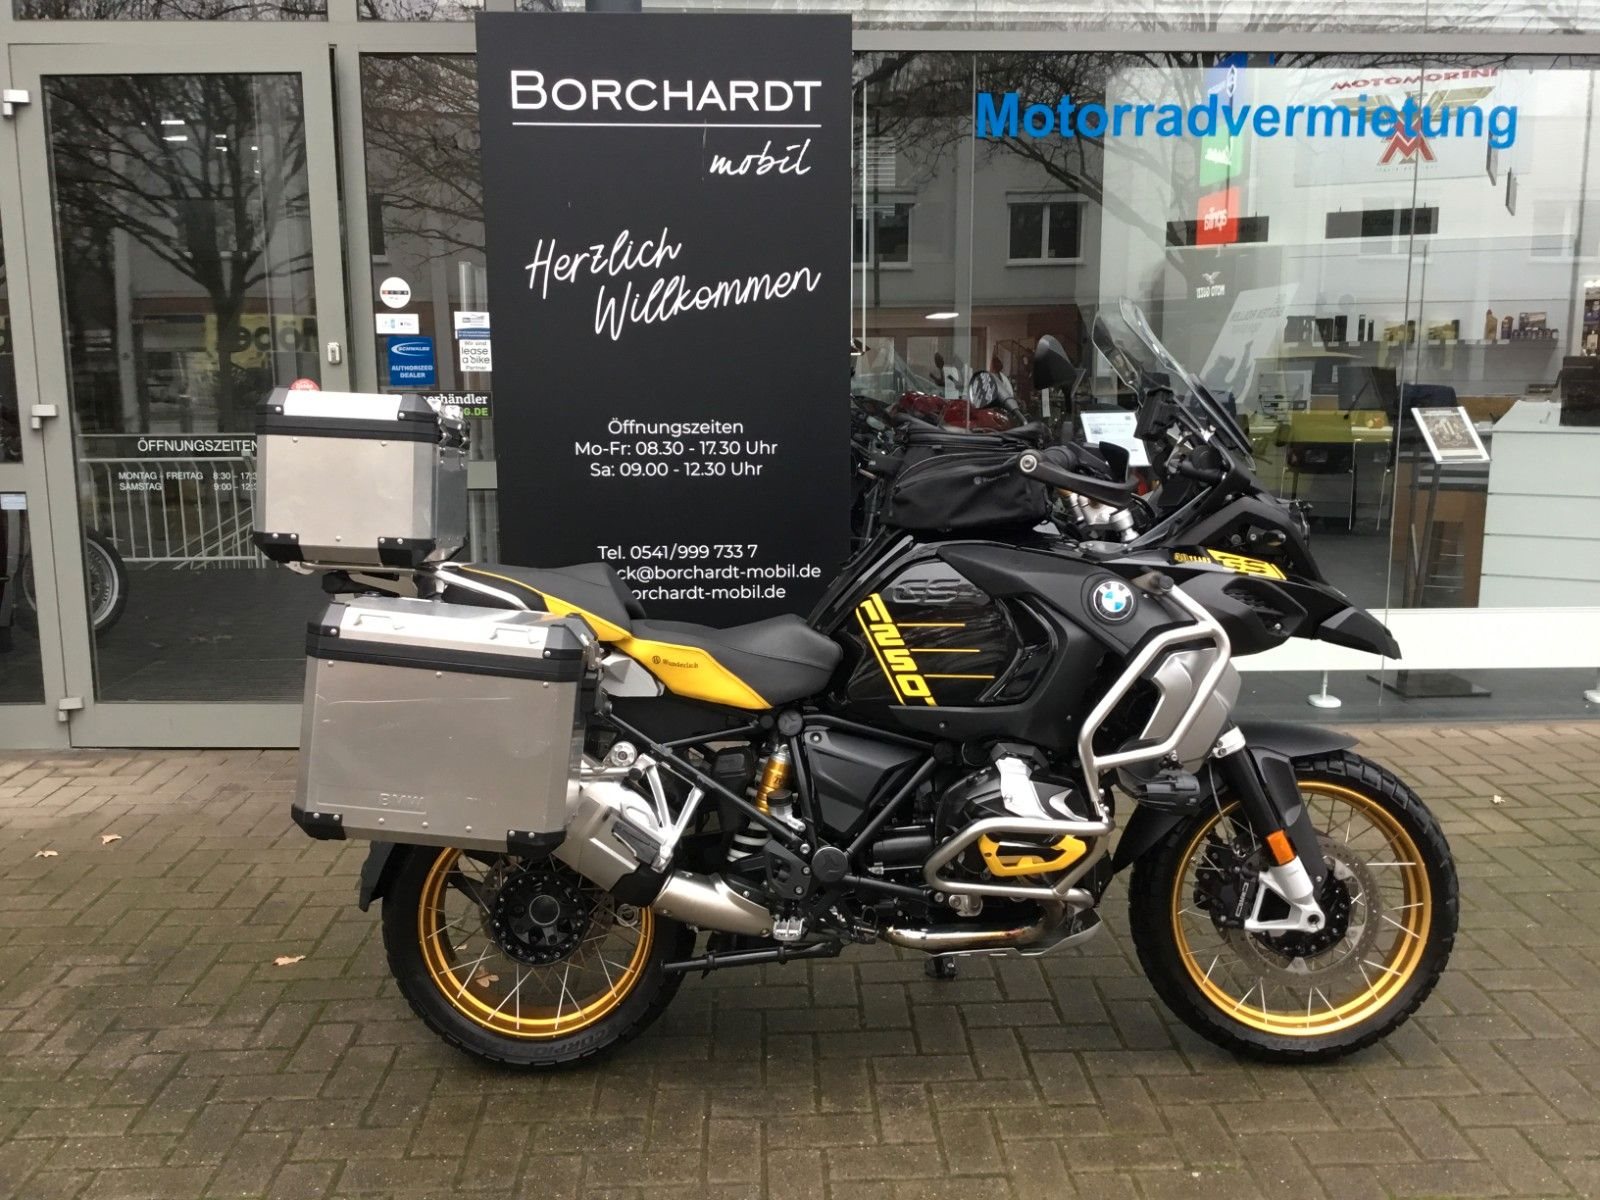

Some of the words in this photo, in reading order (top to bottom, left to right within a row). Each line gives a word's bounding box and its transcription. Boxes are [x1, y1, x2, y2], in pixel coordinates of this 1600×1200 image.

[510, 70, 823, 112] BORCHARDT
[976, 92, 1518, 149] Motorradvermietung
[709, 138, 812, 176] mobil
[525, 227, 682, 300] Herzlich
[594, 266, 822, 341] Willkommen
[461, 347, 488, 356] lease
[462, 356, 469, 364] a
[470, 355, 490, 364] bike
[391, 364, 433, 372] AUTHORIZED
[400, 371, 426, 379] DEALER
[424, 393, 488, 405] erhändler
[608, 417, 744, 437] Öffnungszeiten
[137, 437, 258, 452] ÖFFNUNGSZEITEN
[574, 441, 631, 456] Mo-Fr:
[635, 441, 684, 456] 08.30
[699, 440, 741, 455] 17.30
[746, 440, 778, 455] Uhr
[118, 471, 157, 480] MONTAG
[166, 471, 204, 480] FREITAG
[590, 462, 615, 477] Sa:
[619, 462, 669, 477] 09.00
[684, 462, 726, 477] 12.30
[731, 461, 763, 476] Uhr
[119, 482, 162, 491] SAMSTAG
[597, 545, 626, 560] Tel.
[630, 543, 710, 561] 0541/999
[713, 544, 744, 559] 733
[747, 544, 758, 558] 7
